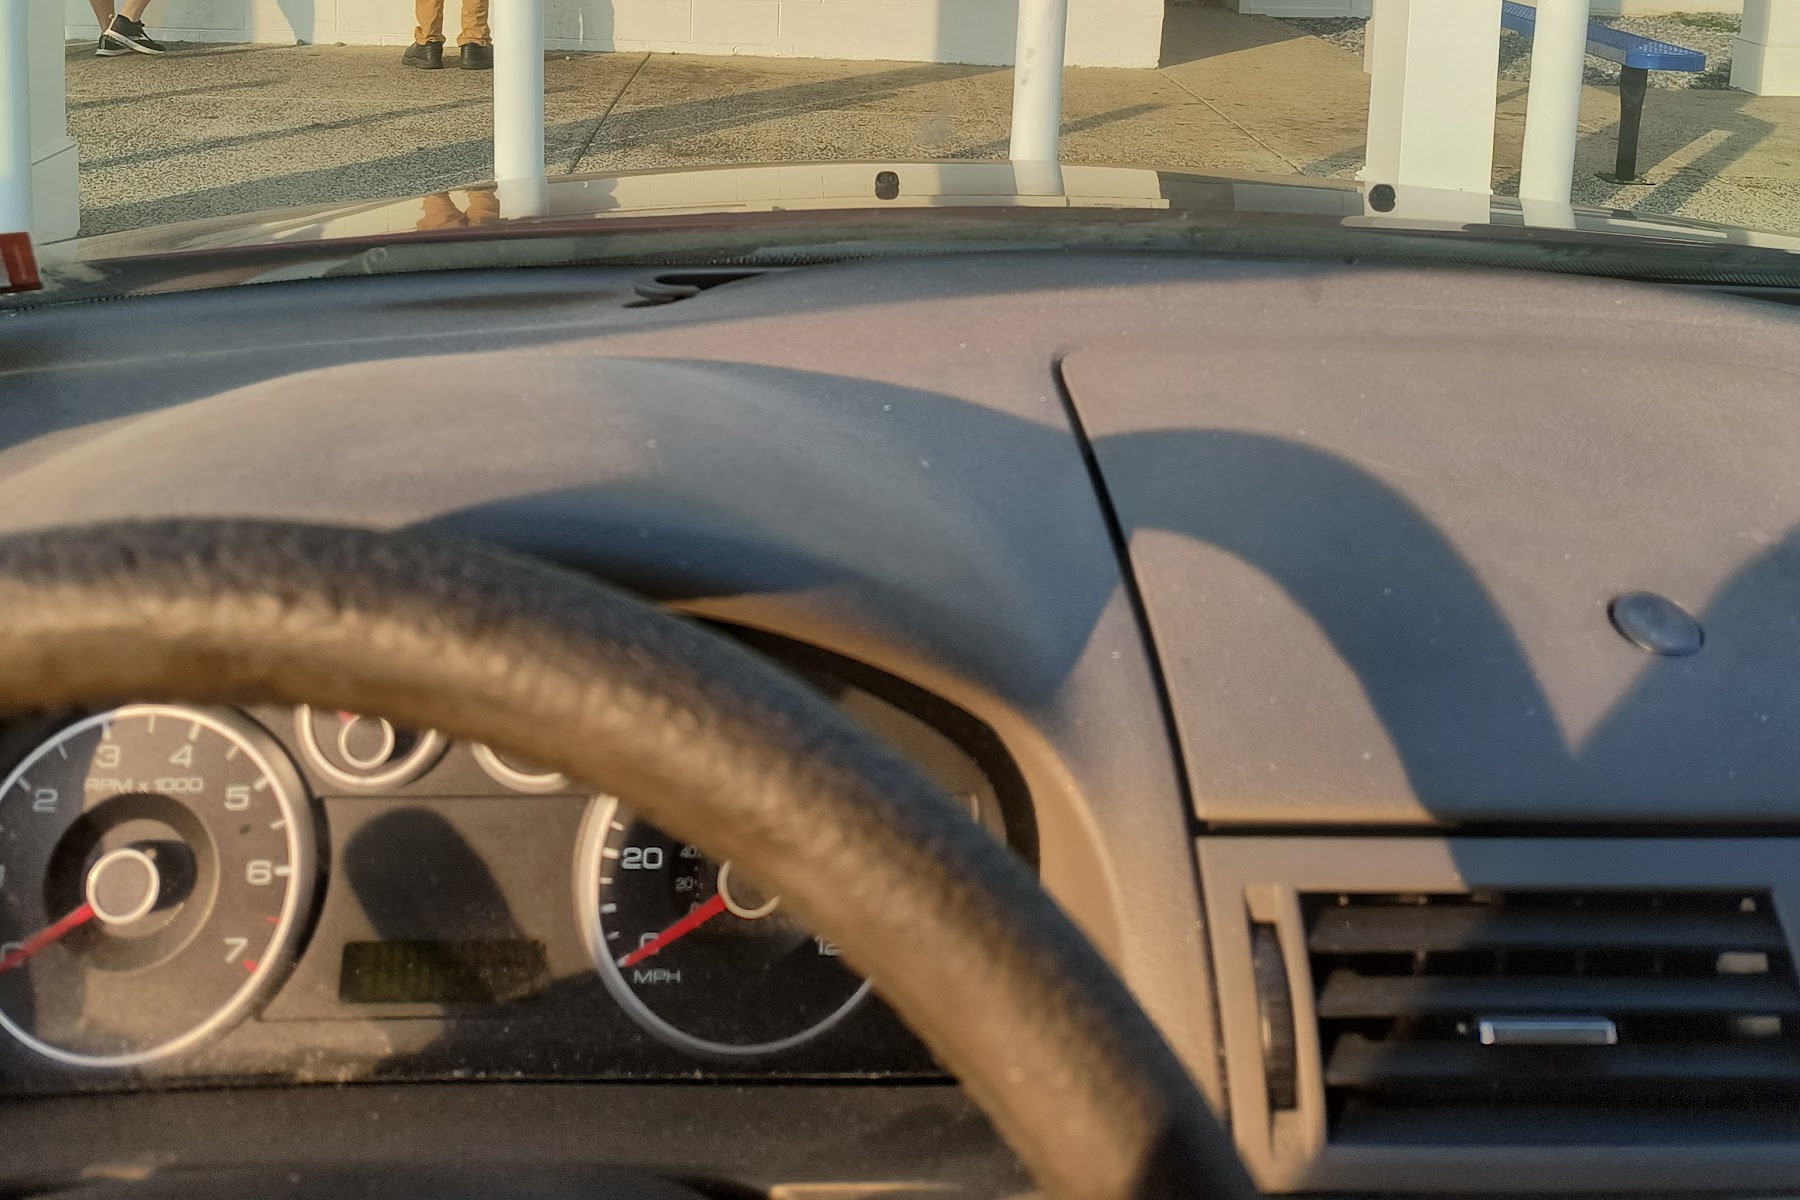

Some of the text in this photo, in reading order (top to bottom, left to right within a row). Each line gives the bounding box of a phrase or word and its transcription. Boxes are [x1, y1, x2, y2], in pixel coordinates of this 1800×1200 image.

[95, 745, 121, 768] 3
[169, 745, 194, 768] 4
[84, 777, 134, 793] RPM
[153, 777, 205, 794] 1000
[32, 788, 58, 812] 2
[223, 787, 251, 812] 5
[622, 847, 664, 870] 20
[245, 860, 274, 886] 6
[223, 938, 249, 963] 7
[634, 969, 681, 984] MPH
